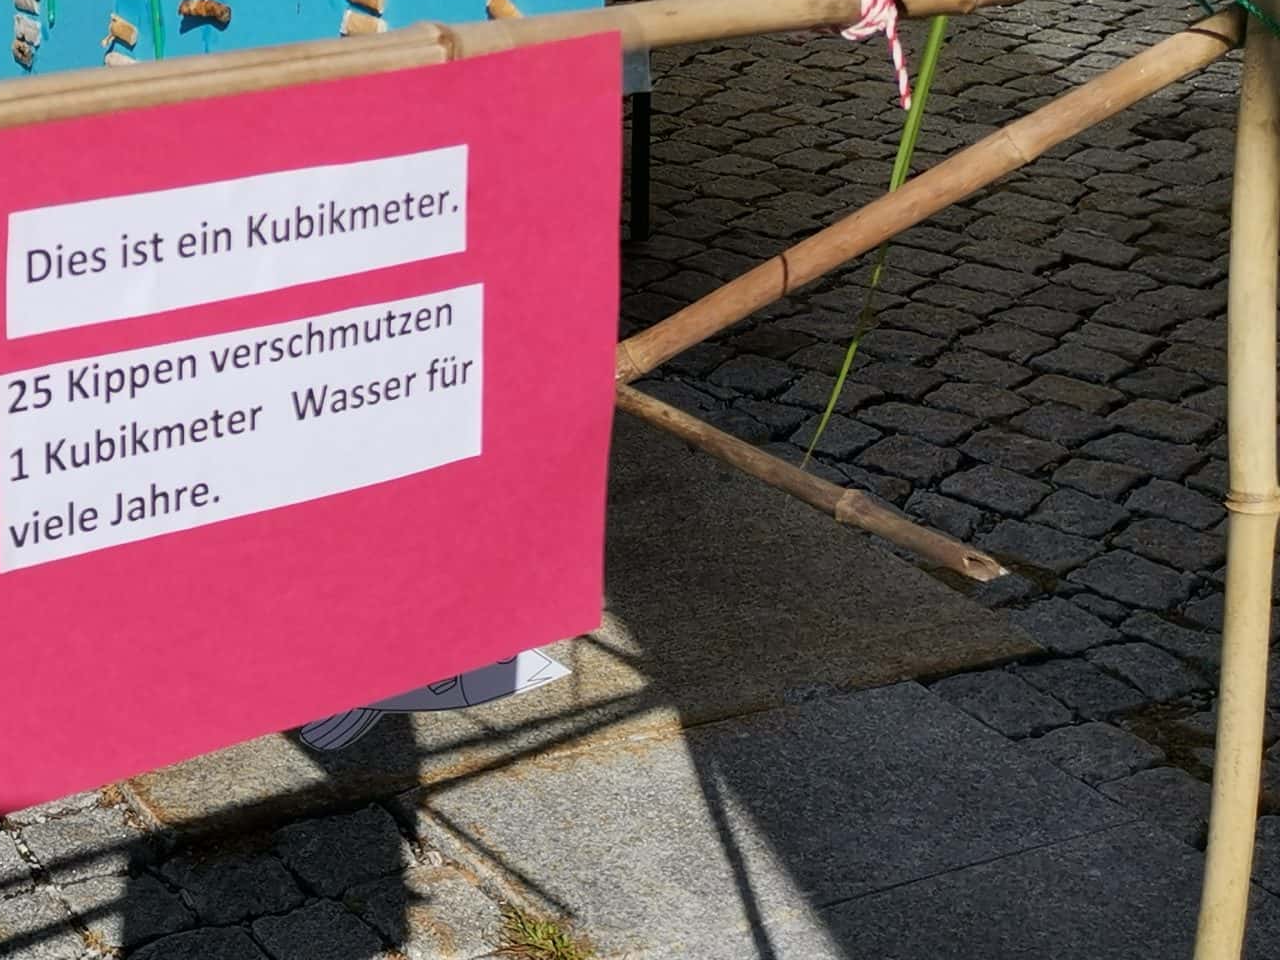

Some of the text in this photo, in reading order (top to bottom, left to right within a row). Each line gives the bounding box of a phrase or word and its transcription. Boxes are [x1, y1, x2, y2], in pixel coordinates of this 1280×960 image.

[25, 188, 460, 284] Dies ist ein Kubikmeter.
[7, 301, 454, 414] 25 Kippen verschmutzen
[10, 355, 473, 482] 1 Kubikmeter Wasser für
[8, 481, 221, 548] viele Jahre.
